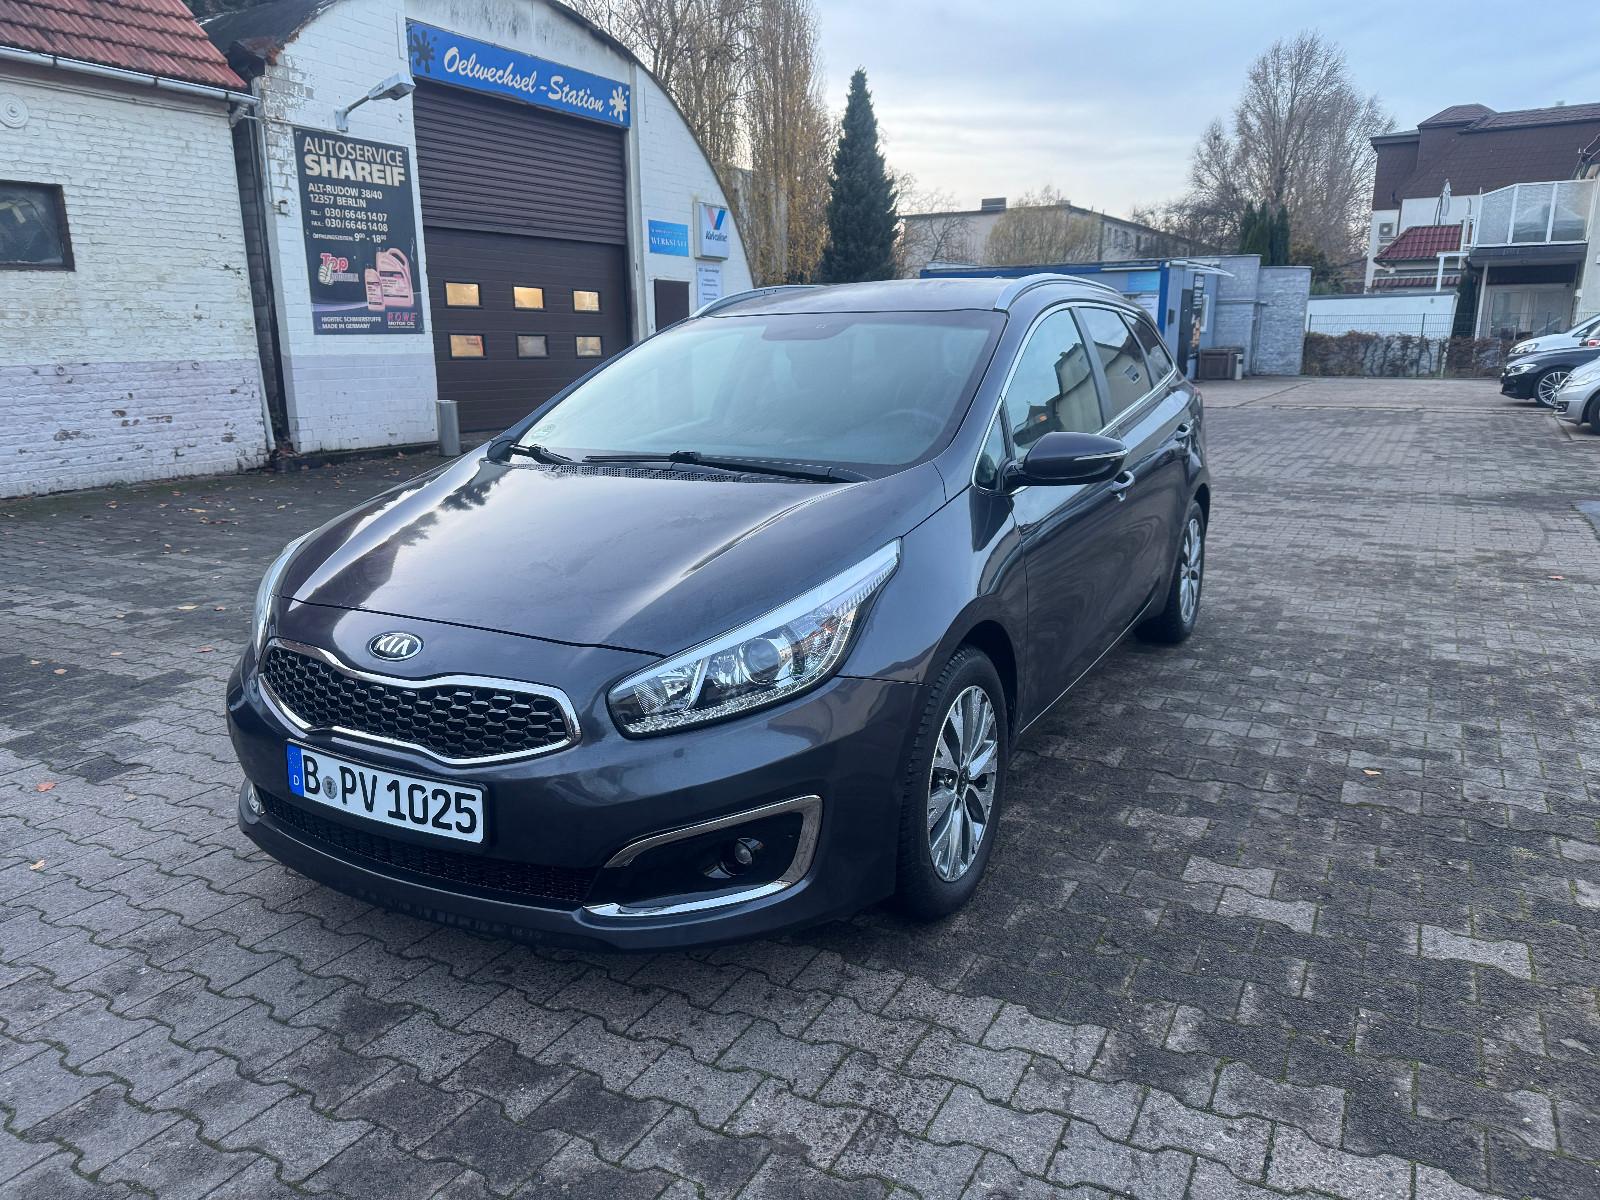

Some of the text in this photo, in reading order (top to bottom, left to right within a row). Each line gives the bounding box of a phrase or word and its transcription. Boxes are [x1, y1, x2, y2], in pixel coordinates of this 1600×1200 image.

[303, 136, 404, 167] AUTOSERVICE
[304, 153, 406, 187] SHAREIF
[308, 182, 383, 200] ALT-RUDOW 38/40
[309, 193, 367, 208] 12357 BERLIN
[373, 634, 411, 656] KIA
[293, 774, 300, 786] D
[302, 754, 478, 834] B PV 1025
